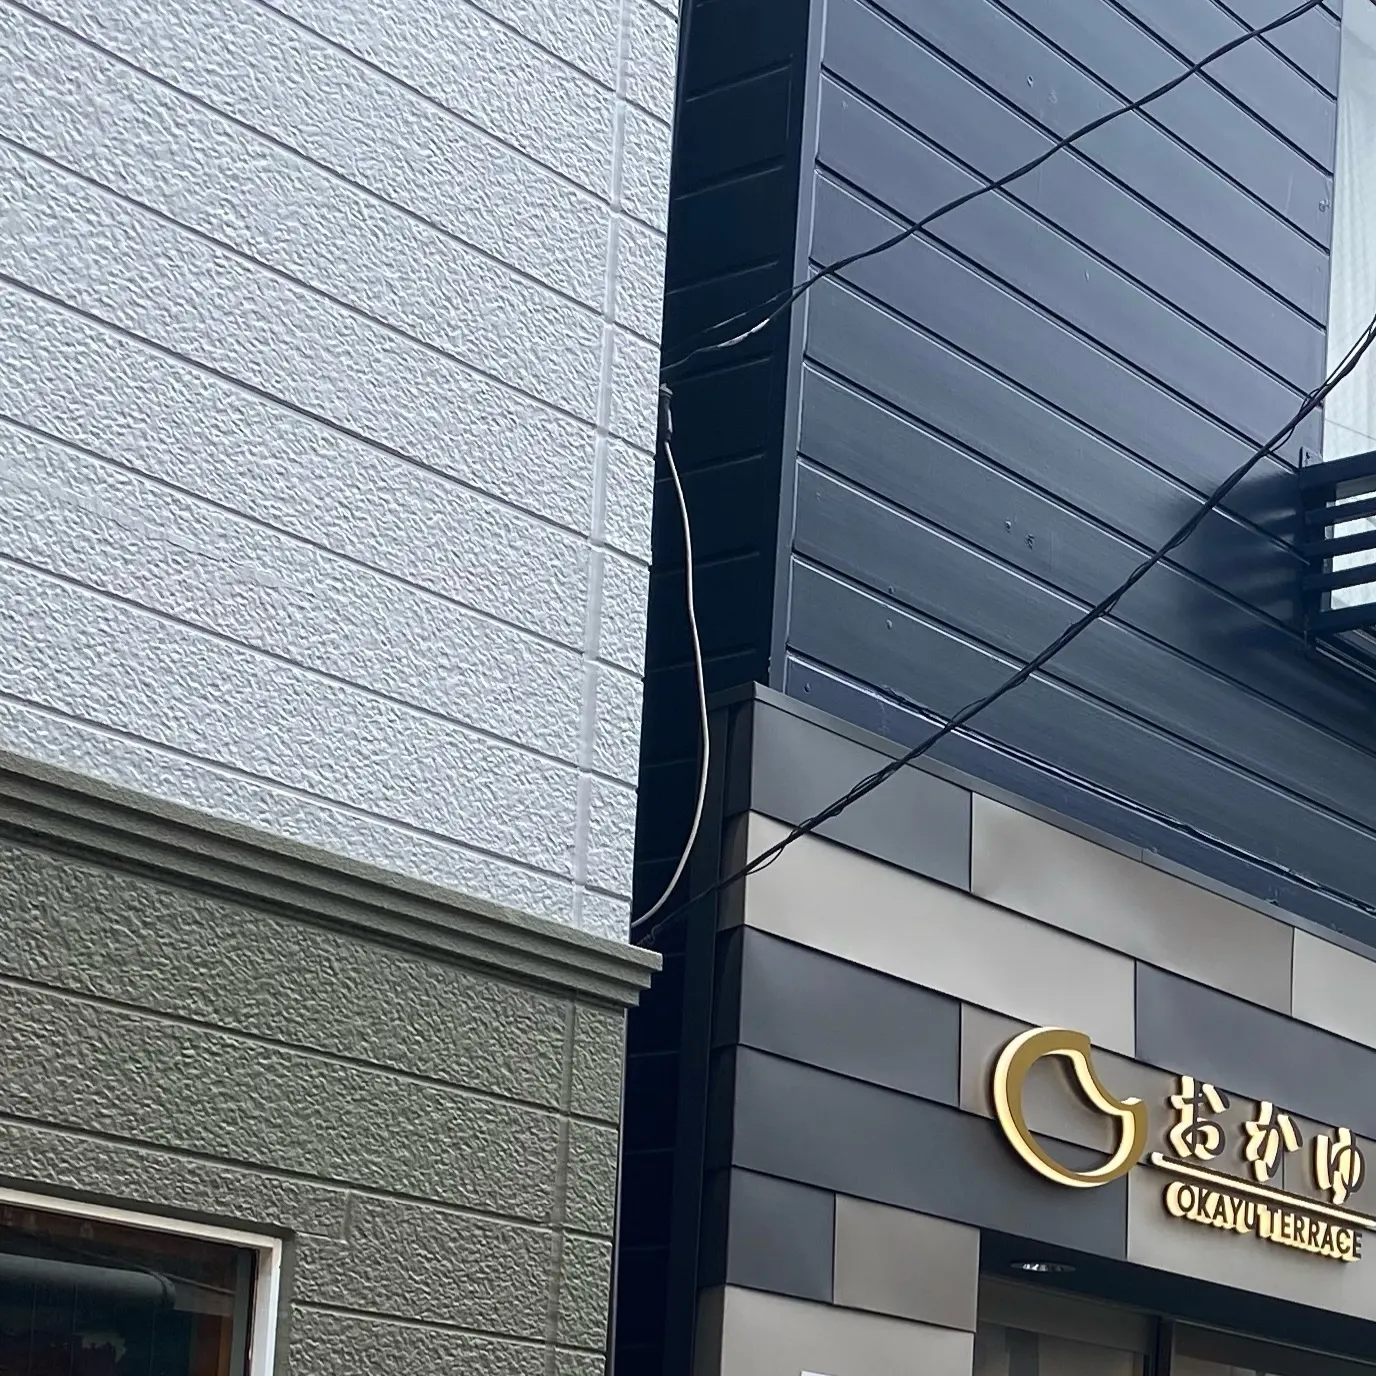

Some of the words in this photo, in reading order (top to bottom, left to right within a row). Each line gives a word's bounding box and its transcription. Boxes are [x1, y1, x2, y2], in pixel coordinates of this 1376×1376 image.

[1167, 1075, 1367, 1205] おかゆ
[1166, 1181, 1260, 1234] OKAYU
[1259, 1208, 1363, 1263] TERRACE
